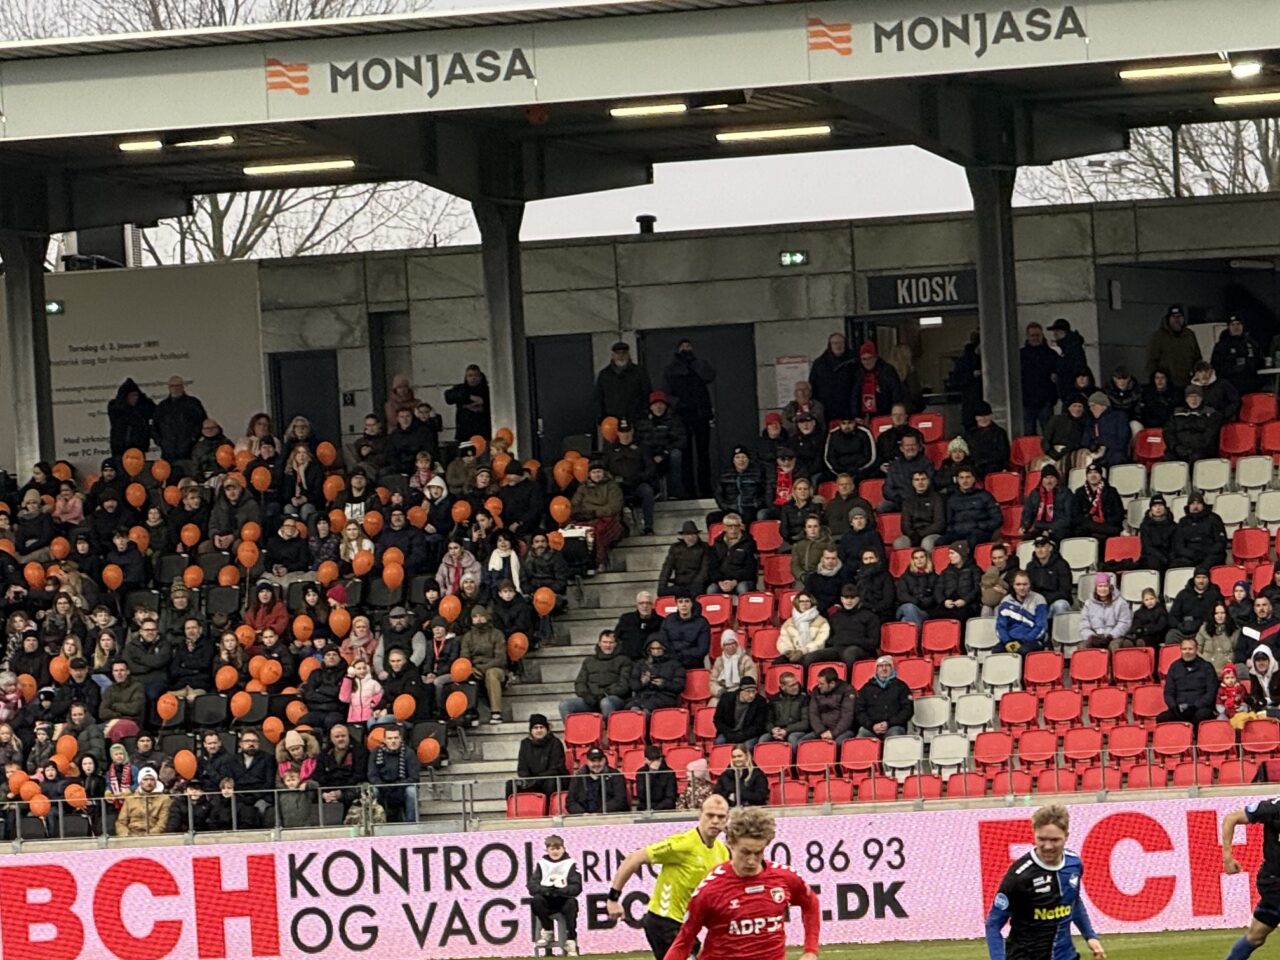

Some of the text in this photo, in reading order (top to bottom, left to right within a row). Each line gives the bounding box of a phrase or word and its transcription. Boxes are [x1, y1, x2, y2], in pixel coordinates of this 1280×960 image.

[874, 5, 1087, 58] MONJASA
[329, 48, 535, 99] MONJASA
[897, 276, 958, 304] KIOSK
[806, 839, 851, 873] 86
[863, 837, 906, 871] 93
[290, 905, 379, 954] OG
[1034, 905, 1072, 920] Netto
